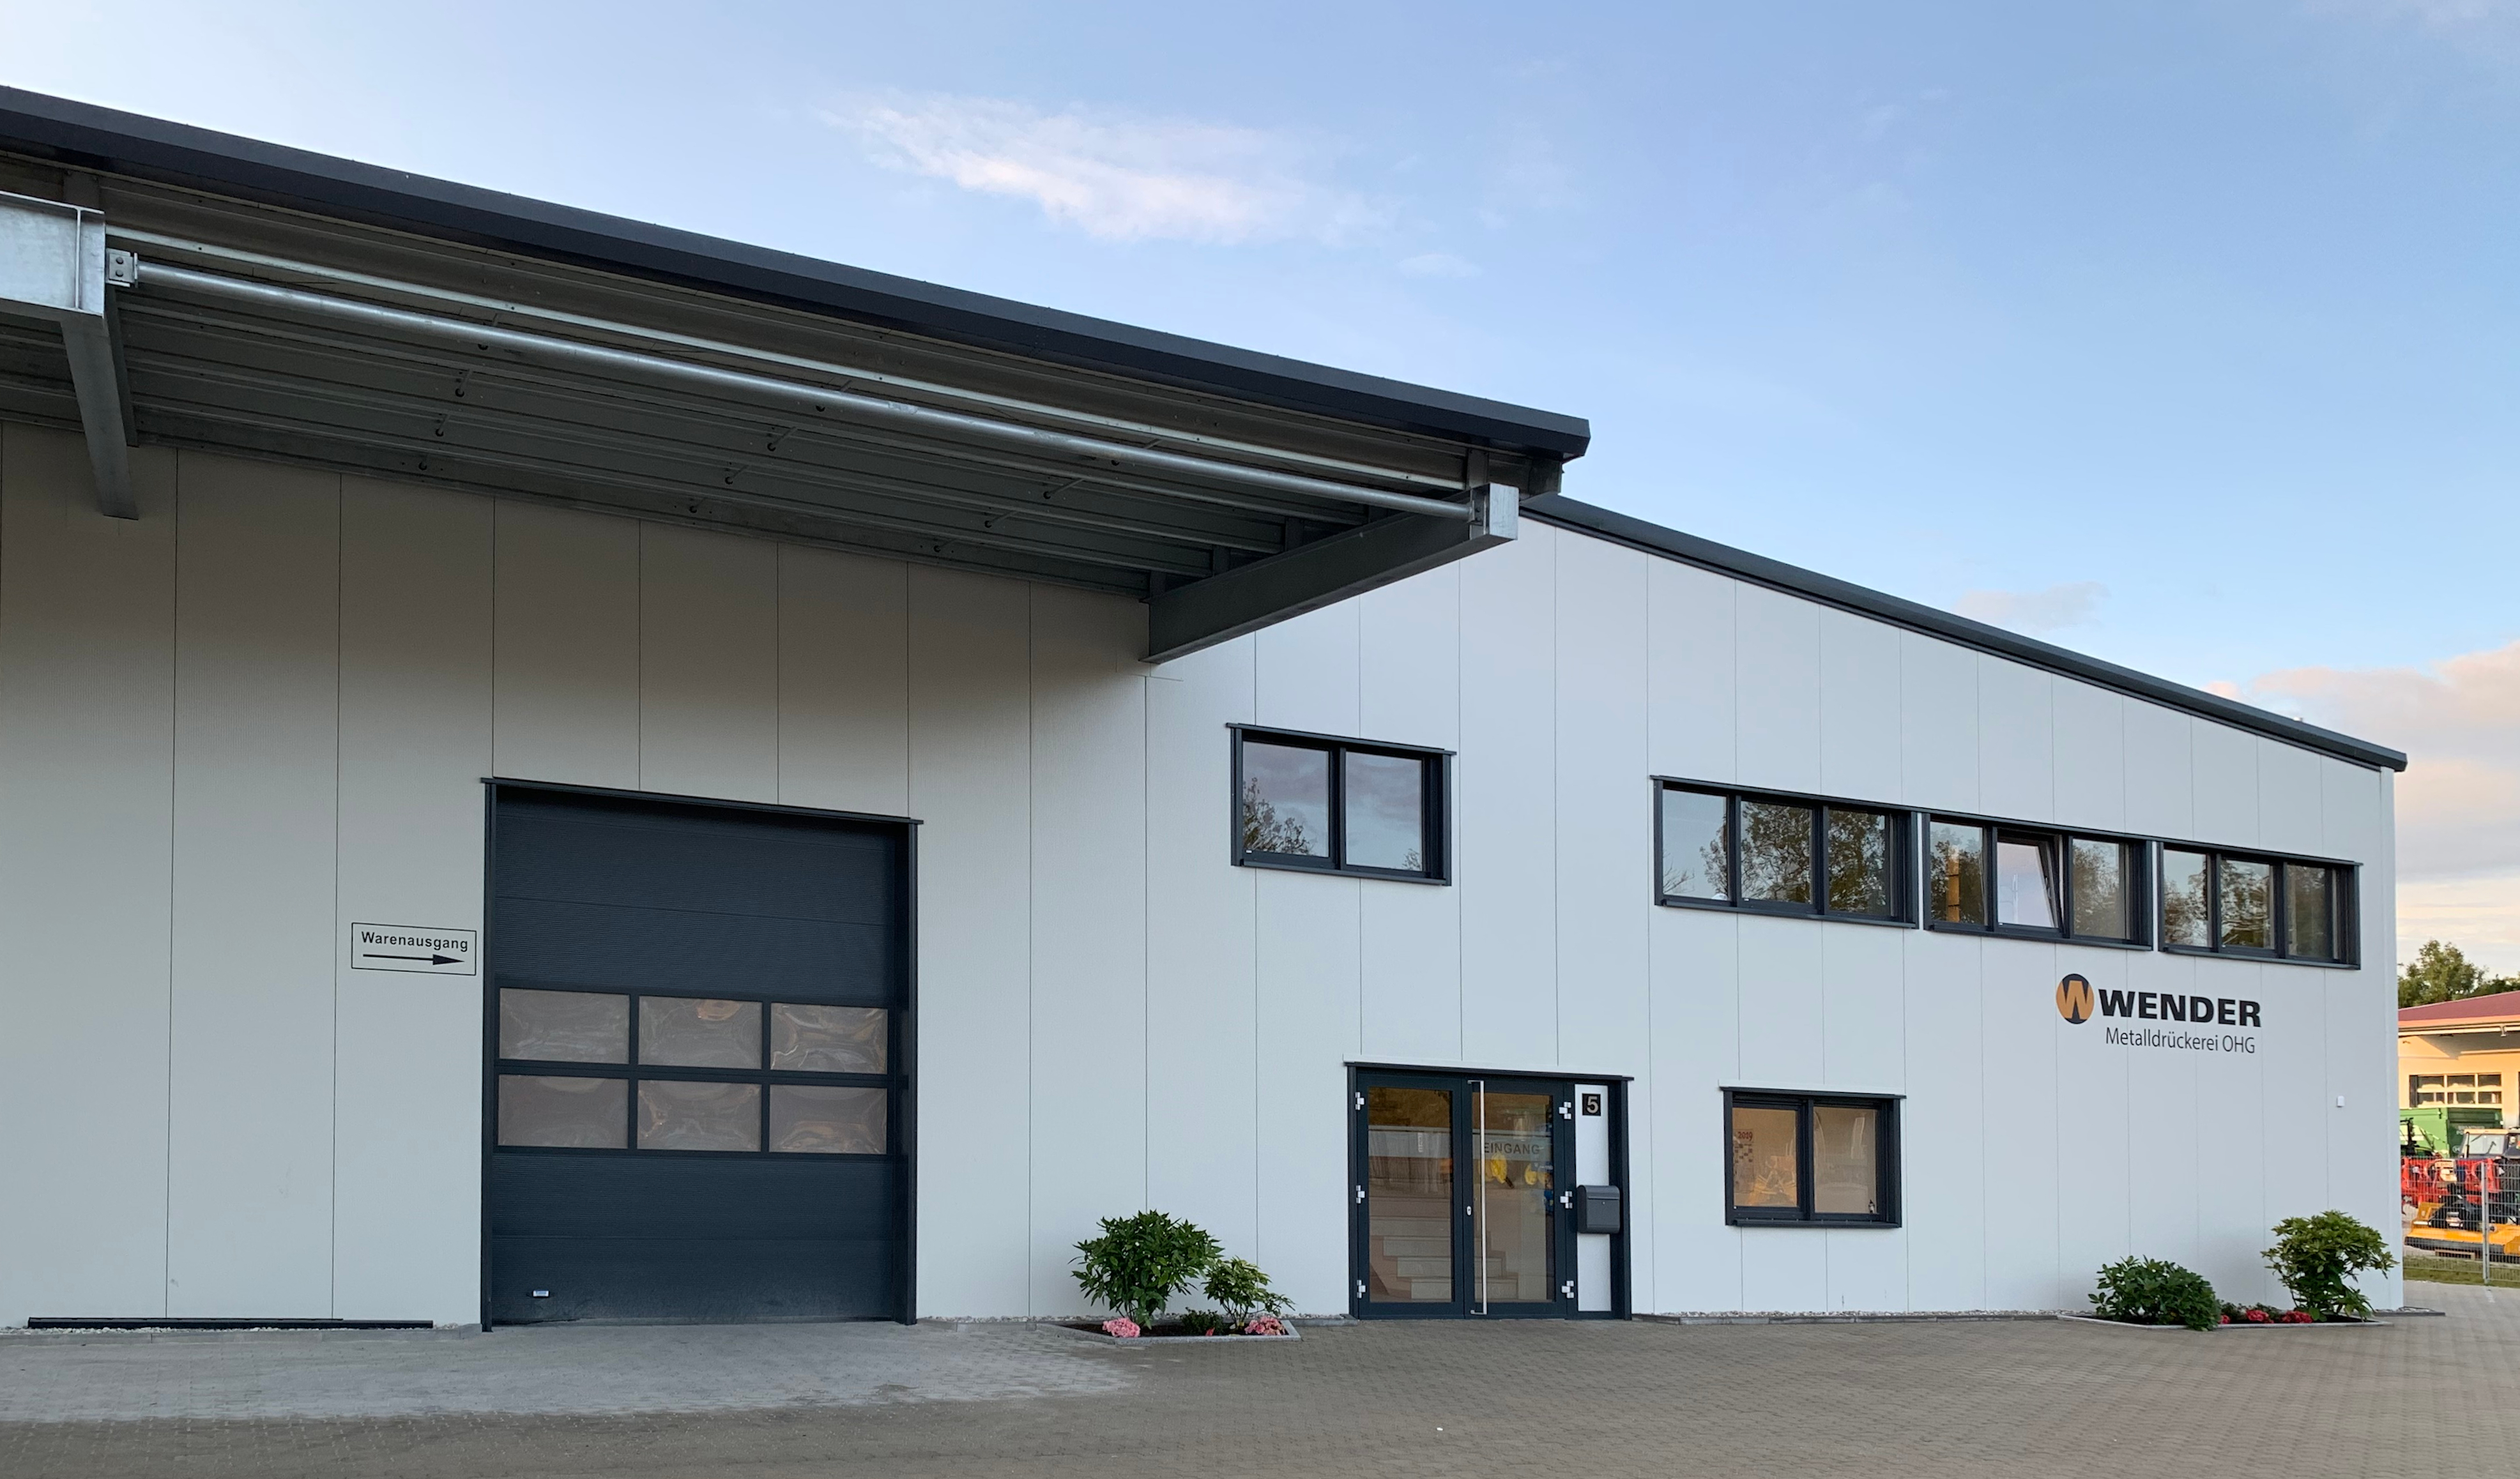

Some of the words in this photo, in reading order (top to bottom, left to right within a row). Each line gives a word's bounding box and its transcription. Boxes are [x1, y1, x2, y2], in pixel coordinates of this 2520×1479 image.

[361, 930, 468, 953] Warenausgang
[2098, 989, 2262, 1028] WENDER
[2105, 1027, 2218, 1051] Metalldrückerei
[2222, 1035, 2256, 1054] OHG
[1586, 1095, 1599, 1114] 5
[1737, 1131, 1753, 1141] 2019
[1485, 1142, 1540, 1155] EINGANG
